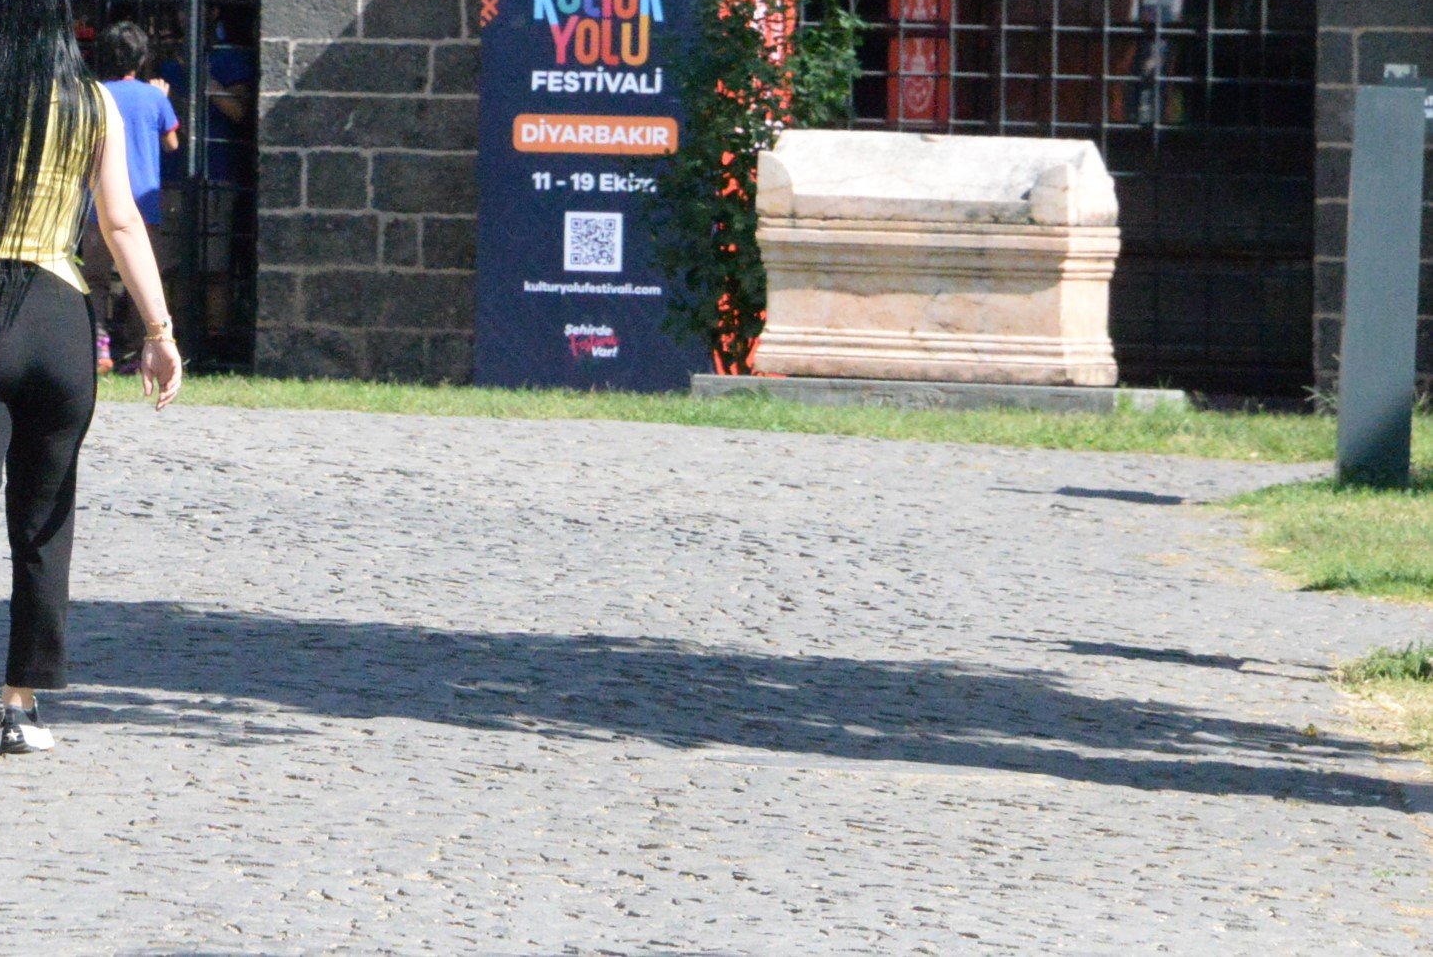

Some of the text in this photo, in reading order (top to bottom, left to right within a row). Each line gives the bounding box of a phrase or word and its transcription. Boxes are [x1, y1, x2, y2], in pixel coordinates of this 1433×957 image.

[552, 14, 649, 66] YOLU
[531, 66, 662, 94] FESTİVALİ
[521, 118, 669, 146] DİYARBAKIR
[532, 171, 551, 190] 11
[570, 173, 595, 192] 19
[523, 280, 662, 295] kulturyolufestivali.com
